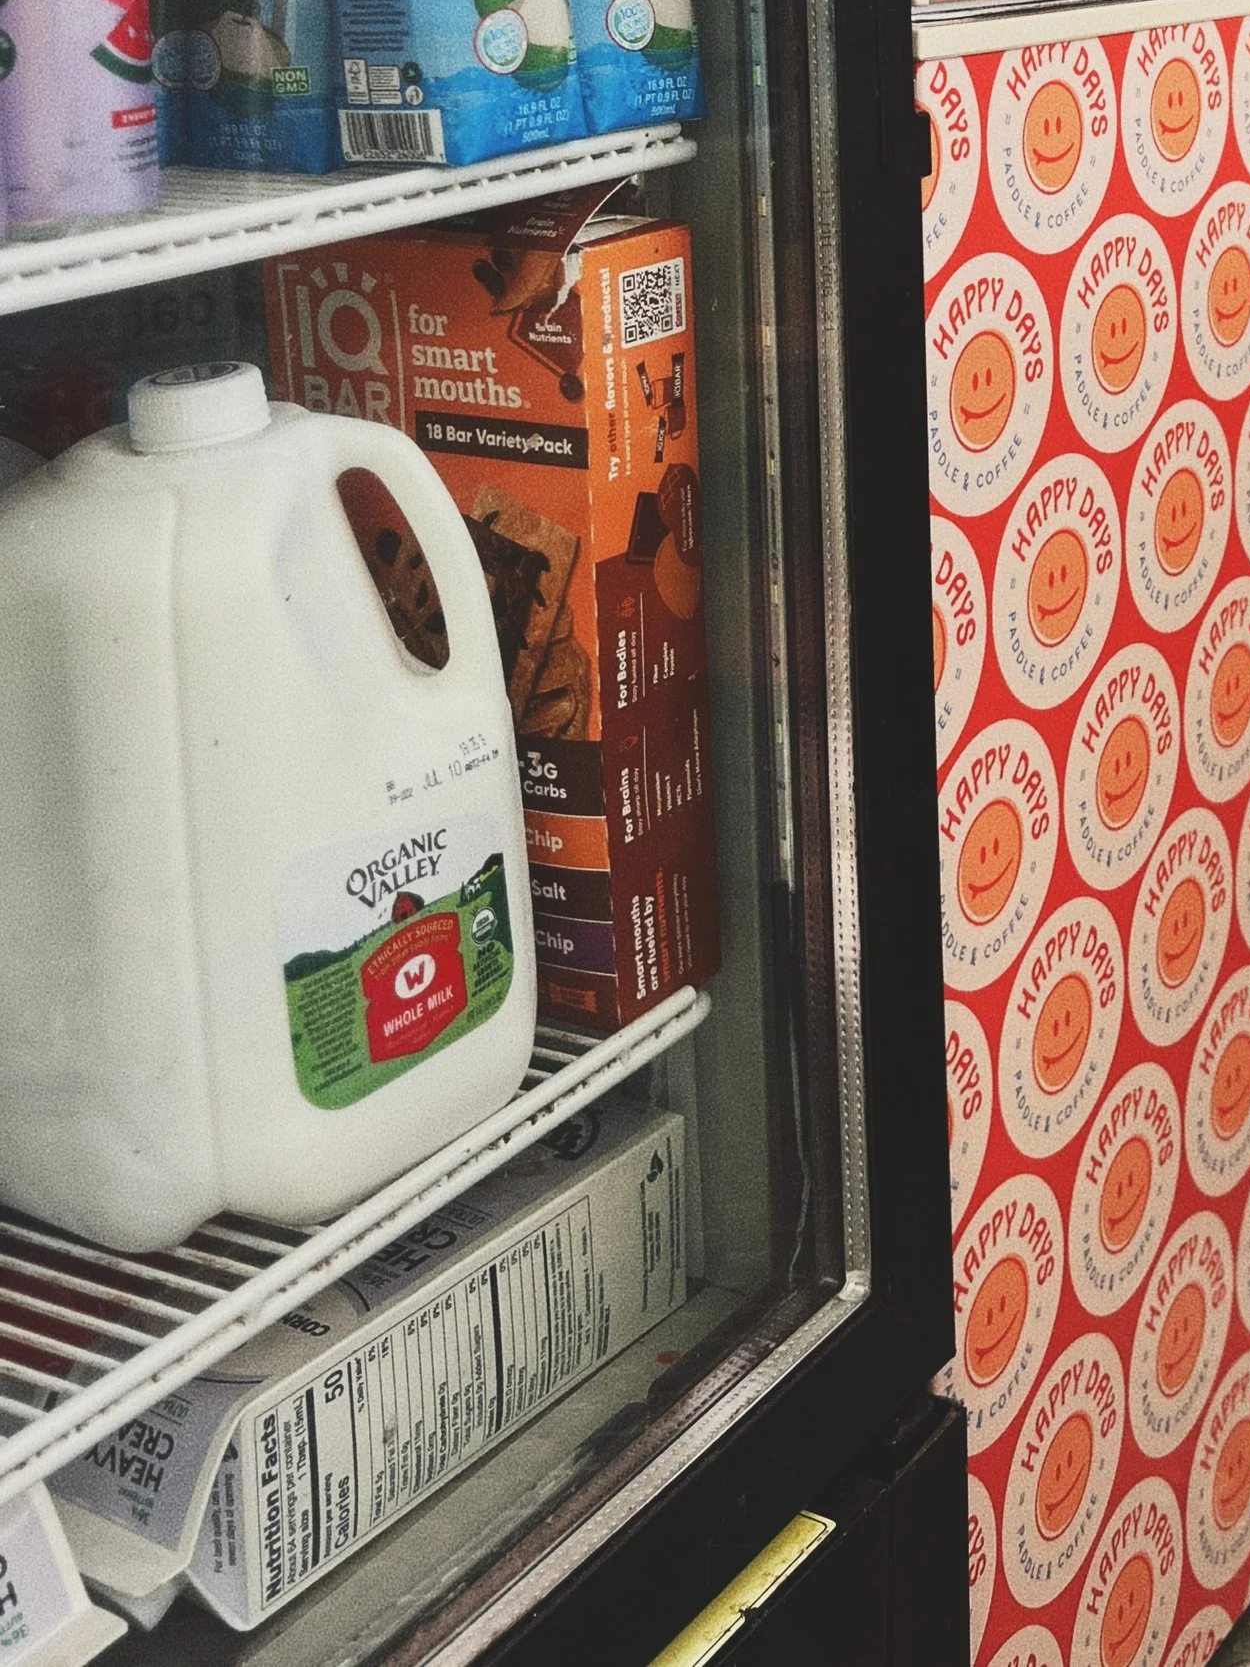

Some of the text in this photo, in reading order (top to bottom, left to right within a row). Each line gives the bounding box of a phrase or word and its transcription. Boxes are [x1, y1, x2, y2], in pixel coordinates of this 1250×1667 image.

[274, 70, 307, 83] NON
[275, 82, 308, 94] GMO
[666, 78, 675, 89] FL
[677, 76, 687, 88] OZ
[1007, 40, 1108, 137] HAPPY DAYS
[1137, 23, 1221, 111] HAPPY DAYS
[538, 99, 548, 111] FL
[550, 96, 562, 109] OZ
[930, 62, 970, 161] DAYS
[1003, 147, 1032, 220] PADDLE
[1047, 185, 1088, 228] COFFEE
[1196, 201, 1245, 269] HAPPY
[1077, 236, 1169, 333] HAPPY DAYS
[408, 304, 448, 337] for
[933, 277, 1043, 382] HAPPY DAYS
[411, 344, 499, 374] smart
[604, 357, 617, 411] flavors
[303, 374, 393, 426] BAR
[414, 377, 533, 410] mouths.
[1074, 354, 1098, 422] PADDLE
[1114, 379, 1151, 427] COFFEE
[425, 423, 573, 456] 18 Bar Variety Pack
[606, 412, 618, 453] other
[929, 410, 959, 483] PADDLE
[976, 434, 1022, 488] COFFEE
[608, 456, 621, 482] Try
[1142, 422, 1224, 512] HAPPY DAYS
[1012, 477, 1113, 574] HAPPY DAYS
[615, 629, 629, 710] For Bodies
[1009, 611, 1035, 678] PADDLE
[1051, 624, 1093, 680] COFFEE
[1082, 665, 1172, 755] HAPPY DAYS
[523, 780, 568, 800] Carbs
[621, 766, 636, 845] For Brains
[941, 743, 1049, 842] HAPPY DAYS
[346, 828, 448, 896] ORGANIC
[526, 827, 564, 853] Chip
[358, 853, 443, 910] VALLEY
[531, 878, 567, 902] Salt
[366, 918, 454, 976] ETHICALLY SOURCED
[534, 929, 575, 955] Chip
[631, 895, 647, 1001] Smart mouths
[643, 896, 659, 992] are fueled by
[1017, 921, 1116, 1020] HAPPY DAYS
[403, 961, 426, 994] W
[382, 1005, 424, 1038] WHOLE
[427, 984, 455, 1012] MILK
[954, 1200, 1055, 1314] HAPPY DAYS
[117, 1417, 175, 1461] CREA
[1021, 1359, 1117, 1472] HAPPY DAYS
[282, 1420, 294, 1471] container
[323, 1368, 351, 1550] Calories 50
[261, 1413, 283, 1602] Nutrition Facts
[284, 1471, 295, 1490] per
[285, 1491, 298, 1537] servings
[298, 1509, 309, 1533] size
[298, 1533, 310, 1577] Serving
